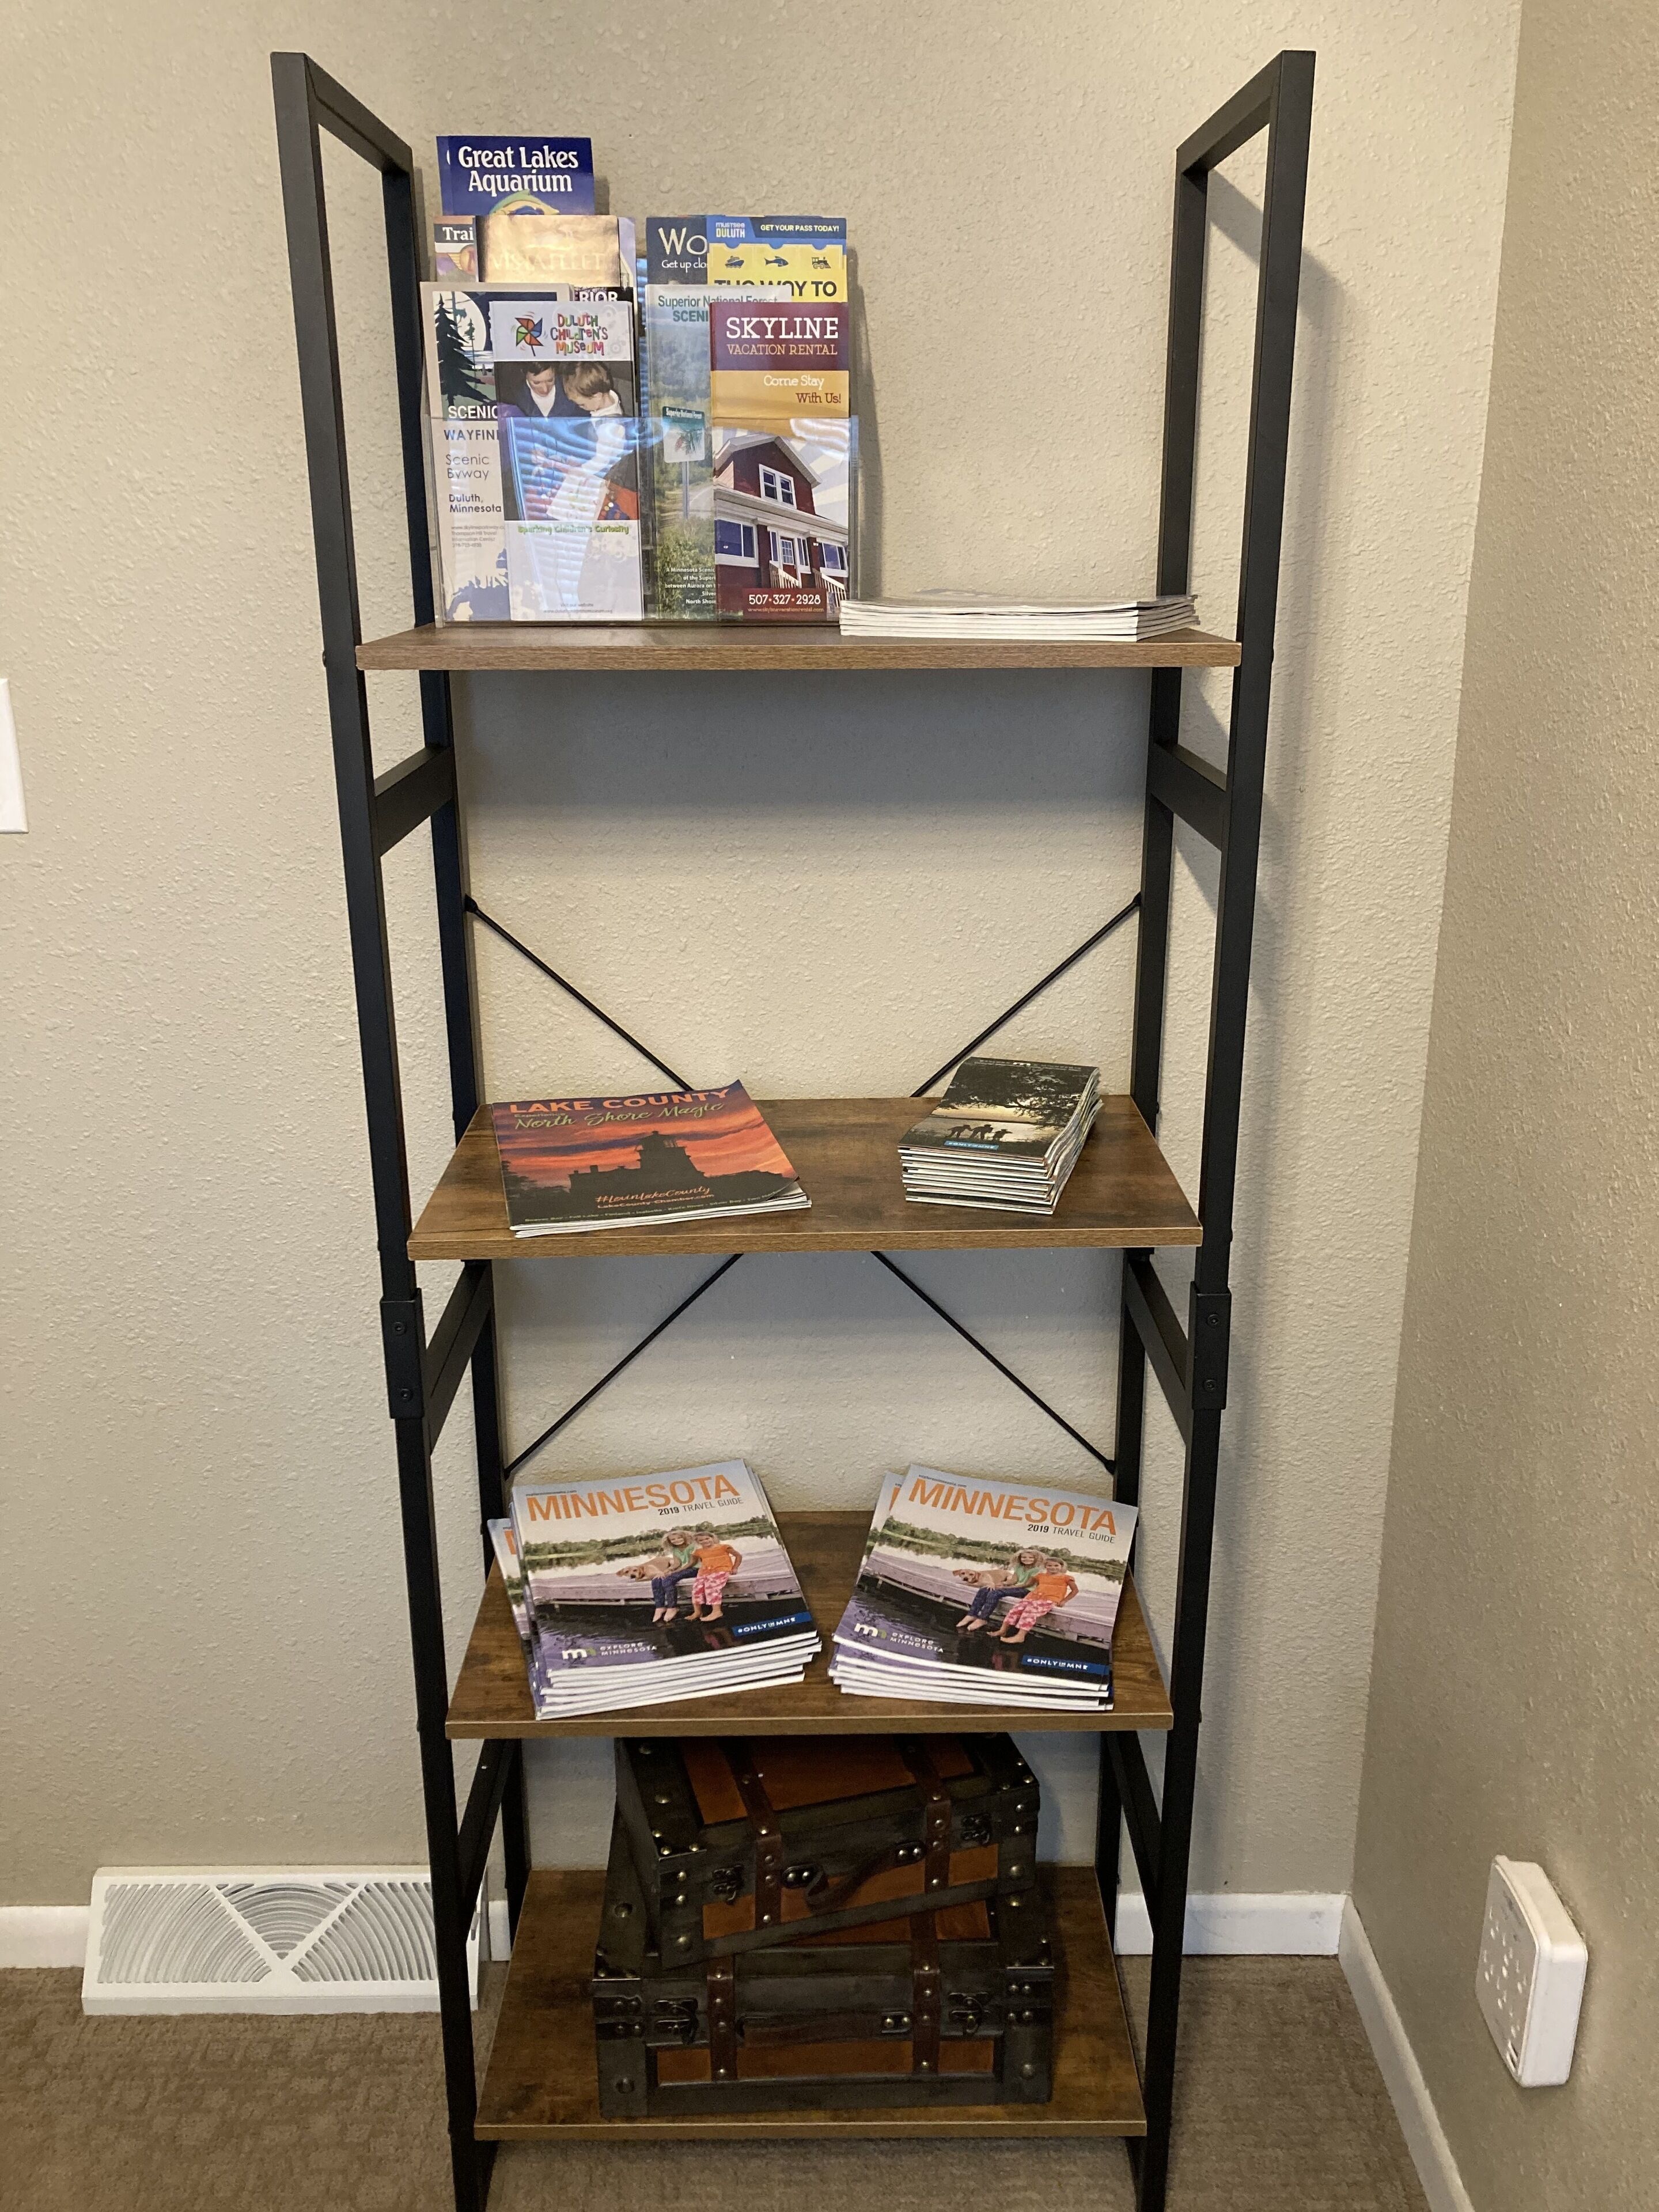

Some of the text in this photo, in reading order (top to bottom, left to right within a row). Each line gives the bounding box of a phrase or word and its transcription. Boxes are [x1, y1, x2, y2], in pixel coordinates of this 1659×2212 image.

[459, 145, 578, 168] Great Lakes
[468, 169, 573, 196] Aquarium
[715, 228, 745, 238] DULUTH
[662, 257, 708, 274] Get up clo
[811, 281, 837, 296] TO
[658, 295, 700, 310] Superior
[726, 317, 839, 339] SKYLINE
[727, 344, 838, 355] VACATION RENTAL
[763, 374, 825, 391] Come Stay
[796, 392, 842, 404] With Us!
[444, 430, 499, 441] WAYFIN
[446, 454, 490, 465] Scenic
[447, 468, 489, 481] Byway
[449, 494, 483, 503] Duluth,
[450, 504, 502, 513] Minnesota
[595, 524, 629, 535] Curiosity
[510, 1088, 730, 1113] LAKE COUNTY
[515, 1103, 725, 1130] North Shore Magic
[527, 1474, 740, 1522] MINNESOTA
[658, 1497, 744, 1516] 2019 TRAVEL GUIDE
[908, 1478, 1117, 1536] MINNESOTA
[1027, 1524, 1115, 1544] 2019 TRAVEL GUIDE
